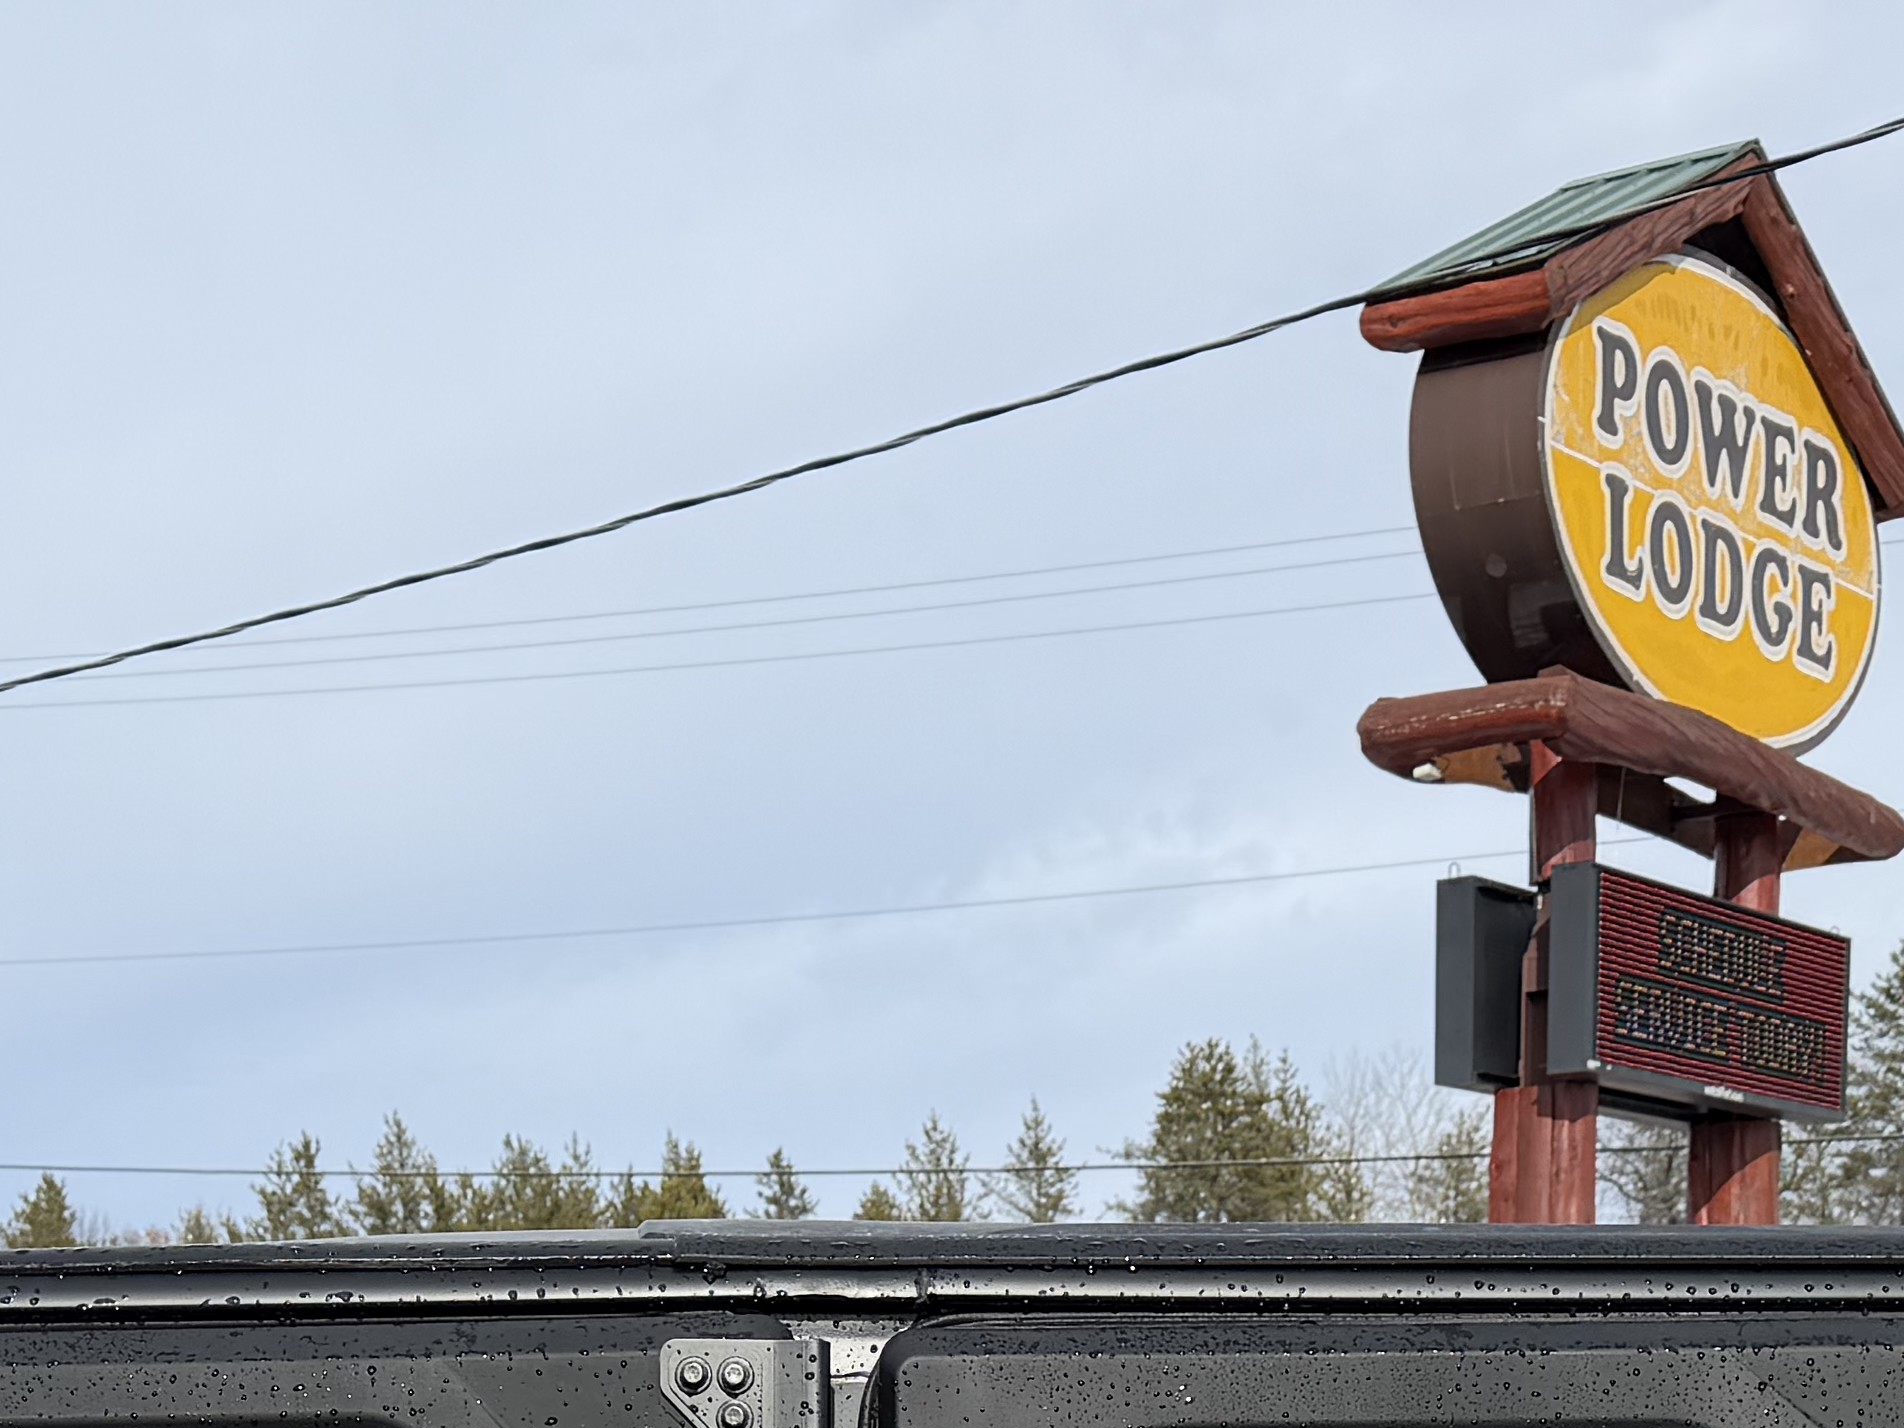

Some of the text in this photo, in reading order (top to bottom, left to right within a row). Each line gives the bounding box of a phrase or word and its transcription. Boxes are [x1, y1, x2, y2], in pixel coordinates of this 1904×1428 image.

[1594, 322, 1845, 555] POWER
[1602, 471, 1835, 673] LODGE
[1615, 980, 1727, 1057] SERVICE
[1659, 914, 1784, 996] SCHEDULE
